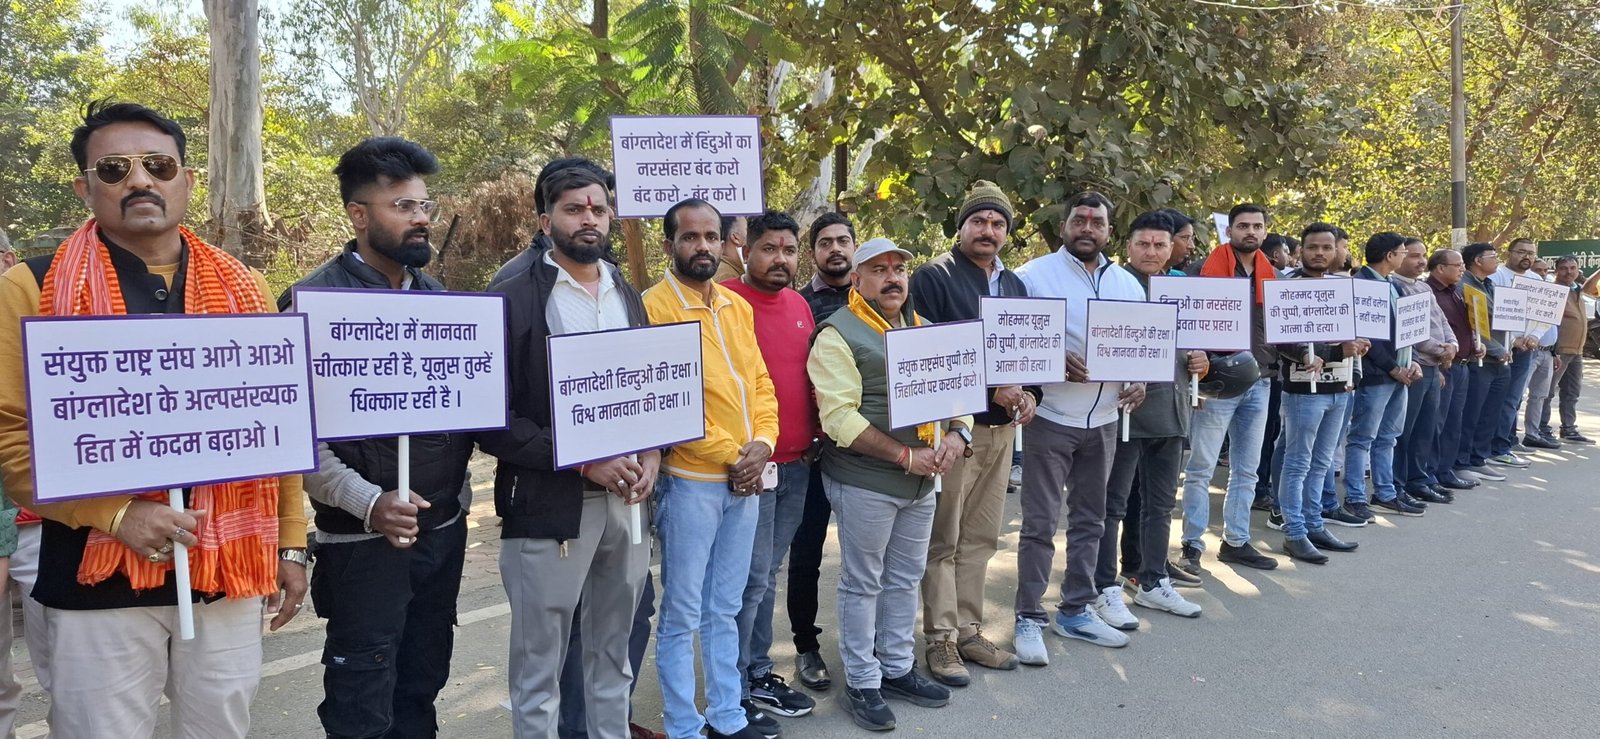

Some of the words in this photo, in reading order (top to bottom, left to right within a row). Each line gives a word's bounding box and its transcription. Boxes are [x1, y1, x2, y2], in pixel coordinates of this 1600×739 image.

[620, 131, 677, 150] बांग्लादेश
[680, 131, 693, 149] में
[695, 130, 733, 154] हिंदुओं
[735, 136, 752, 149] का
[637, 159, 692, 176] नरसंहार
[694, 158, 712, 175] बंद
[714, 157, 739, 175] करो
[633, 186, 651, 202] बंद
[654, 184, 679, 204] करो
[712, 184, 737, 201] करो
[1192, 299, 1204, 310] का
[1206, 297, 1242, 311] नरसंहार
[1280, 289, 1312, 300] मोहम्मद
[1313, 290, 1335, 302] यूनुस
[998, 310, 1030, 326] मोहम्मद
[1031, 314, 1050, 330] यूनुस
[1270, 306, 1280, 317] की
[1282, 305, 1301, 320] चुप्पी,
[1302, 304, 1336, 316] बांग्लादेश
[1338, 304, 1349, 315] की
[329, 317, 399, 341] बांग्लादेश
[403, 317, 419, 340] में
[421, 323, 477, 340] मानवता
[1092, 325, 1123, 338] बांग्लादेशी
[1124, 325, 1147, 342] हिन्दुओं
[1148, 326, 1156, 339] की
[1157, 330, 1170, 340] रक्षा
[1198, 320, 1211, 331] पर
[1212, 320, 1233, 331] प्रहार
[1280, 325, 1302, 333] आत्मा
[1304, 321, 1314, 333] की
[1316, 323, 1333, 332] हत्या
[986, 333, 997, 349] की
[999, 333, 1017, 353] चुप्पी,
[1019, 333, 1051, 349] बांग्लादेश
[1052, 333, 1061, 348] की
[1097, 344, 1111, 357] विश्व
[1112, 347, 1137, 357] मानवता
[1138, 345, 1147, 358] की
[1148, 348, 1160, 358] रक्षा
[42, 346, 108, 382] संयुक्त
[113, 349, 153, 376] राष्ट्र
[157, 343, 195, 370] संघ
[202, 340, 242, 368] आगे
[248, 338, 294, 366] आओ
[313, 352, 369, 377] चीत्कार
[372, 352, 398, 376] रही
[402, 352, 416, 378] है,
[421, 357, 460, 380] यूनुस
[463, 351, 493, 379] तुम्हें
[897, 358, 918, 377] संयुक्त
[919, 354, 944, 372] राष्ट्रसंघ
[946, 350, 961, 371] चुप्पी
[962, 348, 976, 366] तोड़ो
[996, 360, 1018, 372] आत्मा
[1019, 356, 1029, 371] की
[1030, 360, 1046, 371] हत्या
[559, 369, 613, 396] बांग्लादेशी
[615, 364, 653, 390] हिन्दुओं
[655, 361, 669, 381] की
[671, 363, 691, 379] रक्षा
[894, 379, 926, 399] जिहादियों
[927, 380, 937, 393] पर
[938, 373, 961, 391] करवाई
[963, 371, 977, 387] करो
[51, 387, 152, 420] बांग्लादेश
[157, 385, 178, 413] के
[185, 381, 298, 411] अल्पसंख्यक
[350, 388, 408, 412] धिक्कार
[411, 386, 437, 409] रही
[440, 385, 451, 408] है
[571, 404, 595, 426] विश्व
[598, 399, 640, 420] मानवता
[642, 392, 656, 412] की
[658, 393, 679, 410] रक्षा
[74, 434, 116, 465] हित
[120, 430, 144, 459] में
[147, 432, 202, 457] कदम
[206, 420, 266, 456] बढ़ाओ
